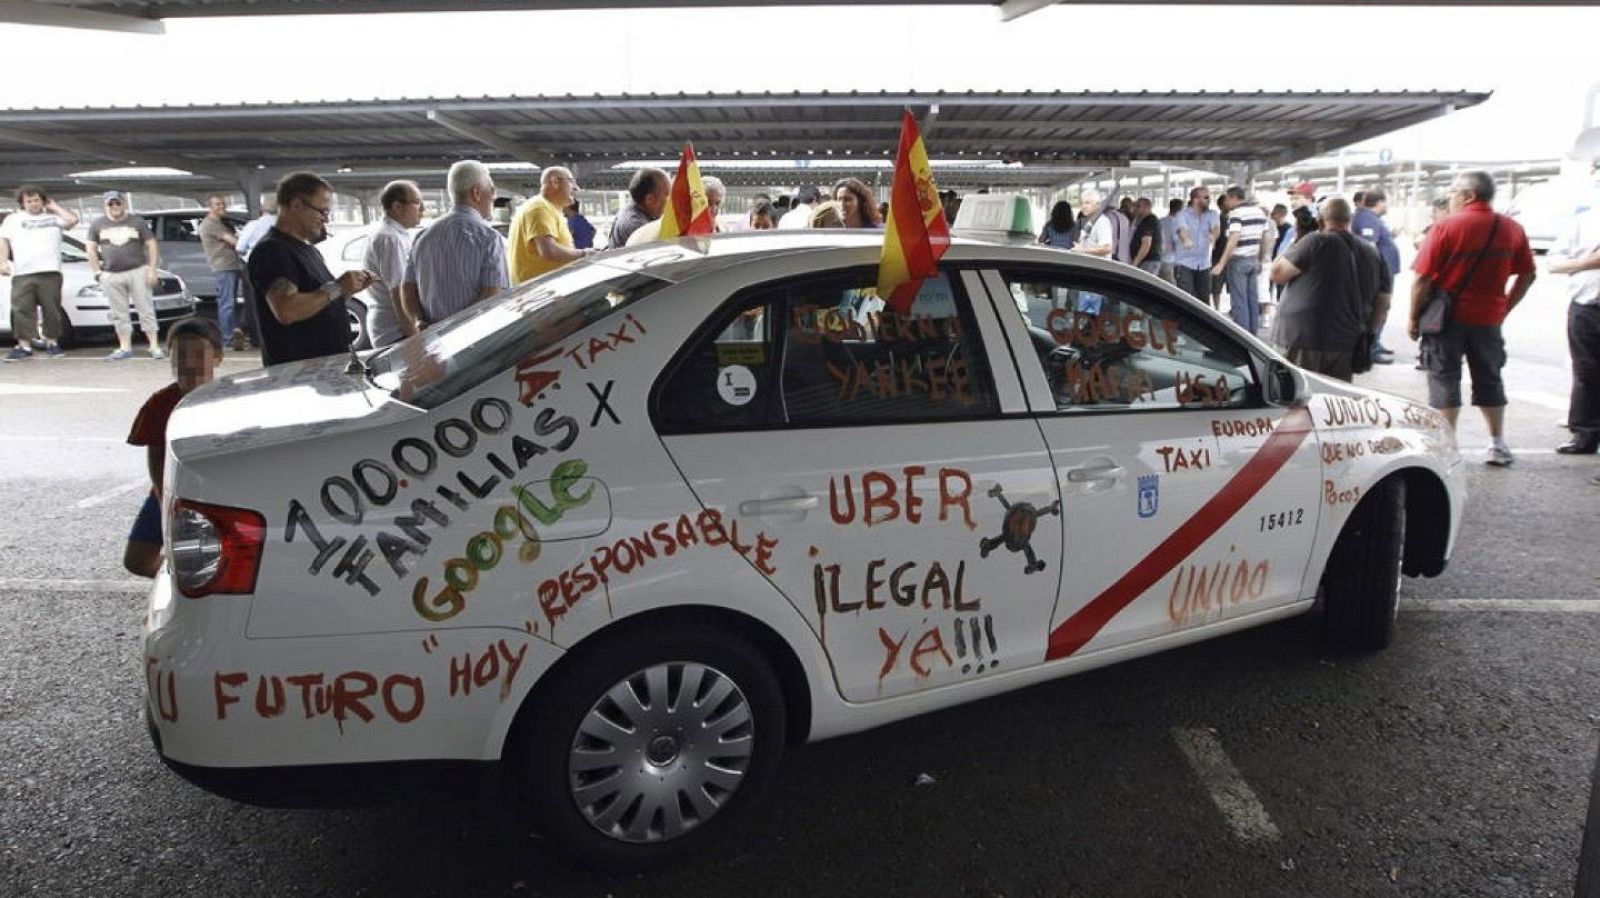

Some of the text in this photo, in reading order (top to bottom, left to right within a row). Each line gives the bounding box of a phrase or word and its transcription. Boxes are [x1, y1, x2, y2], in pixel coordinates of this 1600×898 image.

[1211, 417, 1274, 438] EUROPA
[1323, 397, 1392, 428] JUNTOS
[1156, 445, 1210, 472] TAXI
[1321, 442, 1343, 464] QUE
[1346, 442, 1364, 458] NO
[284, 397, 513, 576] 100.000
[333, 380, 621, 597] FAMILIAS X
[829, 466, 977, 531] UBER
[1260, 508, 1304, 532] 15412
[537, 508, 778, 625] RESPONSABLE
[214, 670, 425, 725] FUTURO
